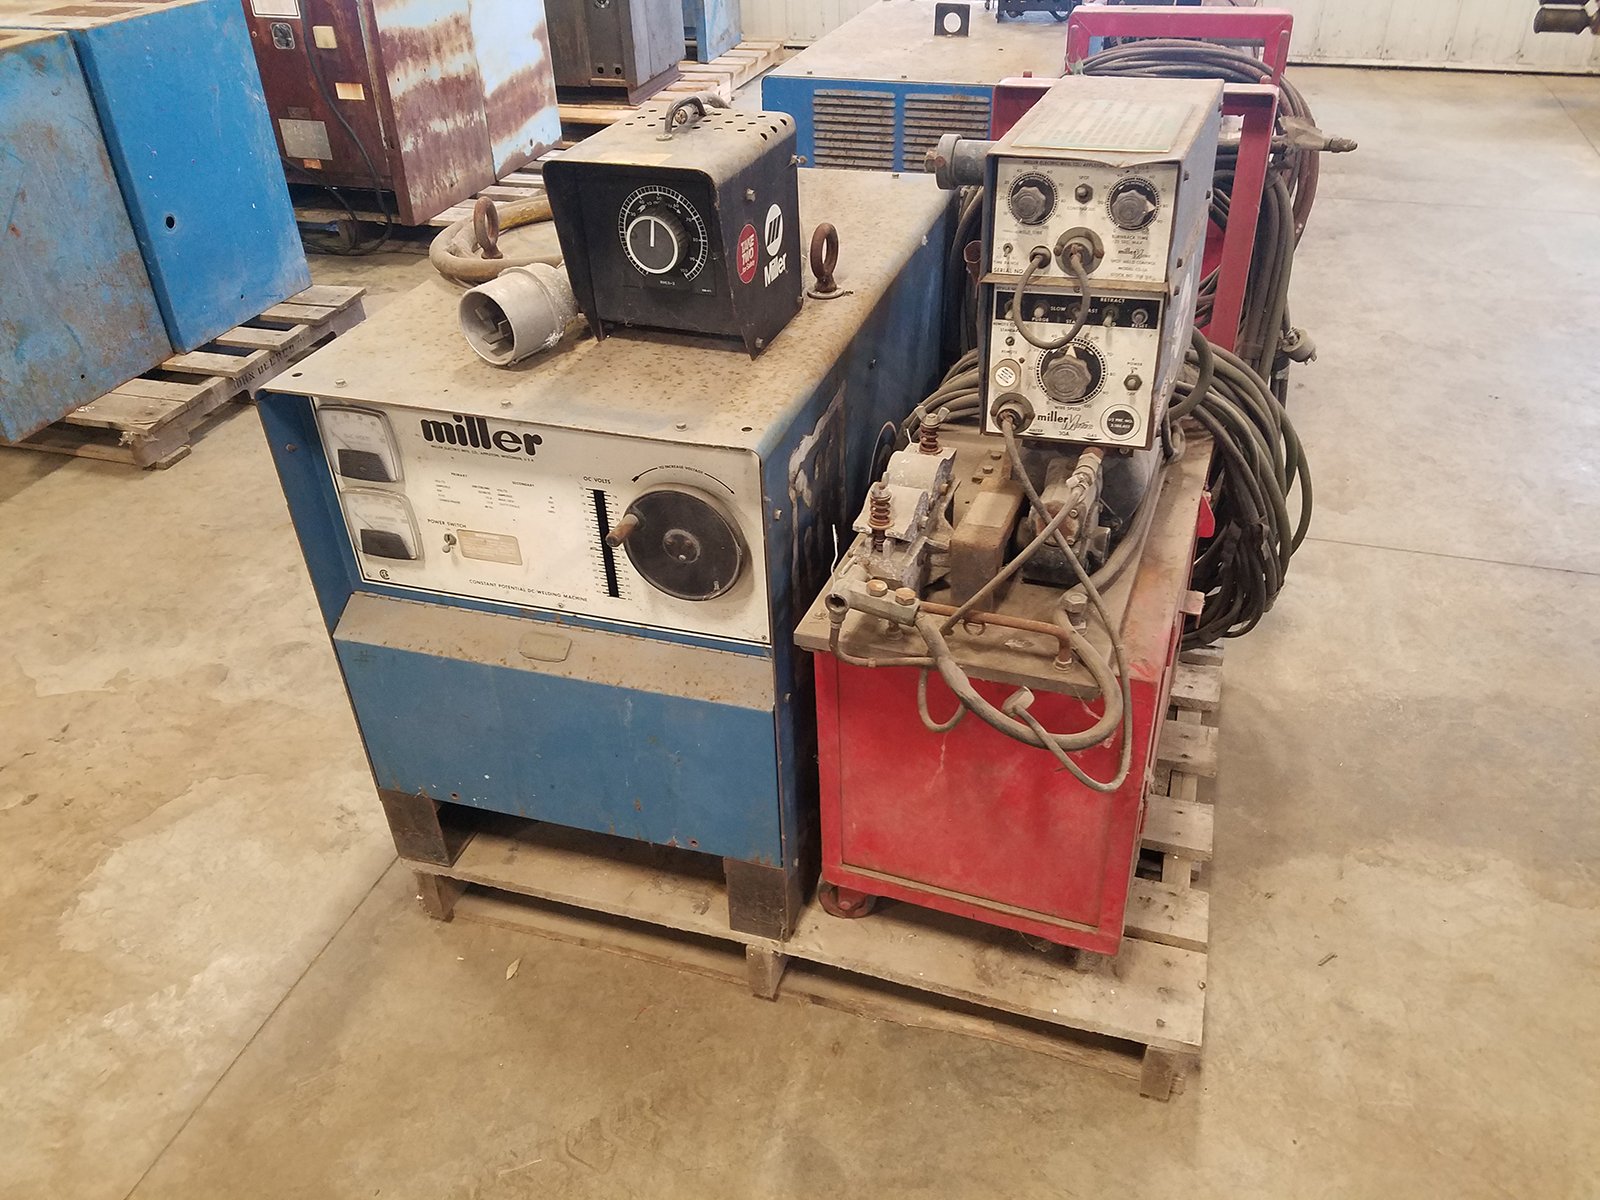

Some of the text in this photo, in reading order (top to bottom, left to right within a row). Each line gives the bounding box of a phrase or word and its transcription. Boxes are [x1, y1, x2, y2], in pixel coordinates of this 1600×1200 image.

[764, 252, 787, 288] Miller
[1038, 410, 1068, 424] miller
[420, 414, 543, 456] miller
[426, 518, 446, 526] POWER
[468, 578, 497, 588] CONSTANT
[498, 583, 526, 592] POTENTIAL
[536, 590, 562, 598] WELDING
[562, 594, 588, 602] MACHINE
